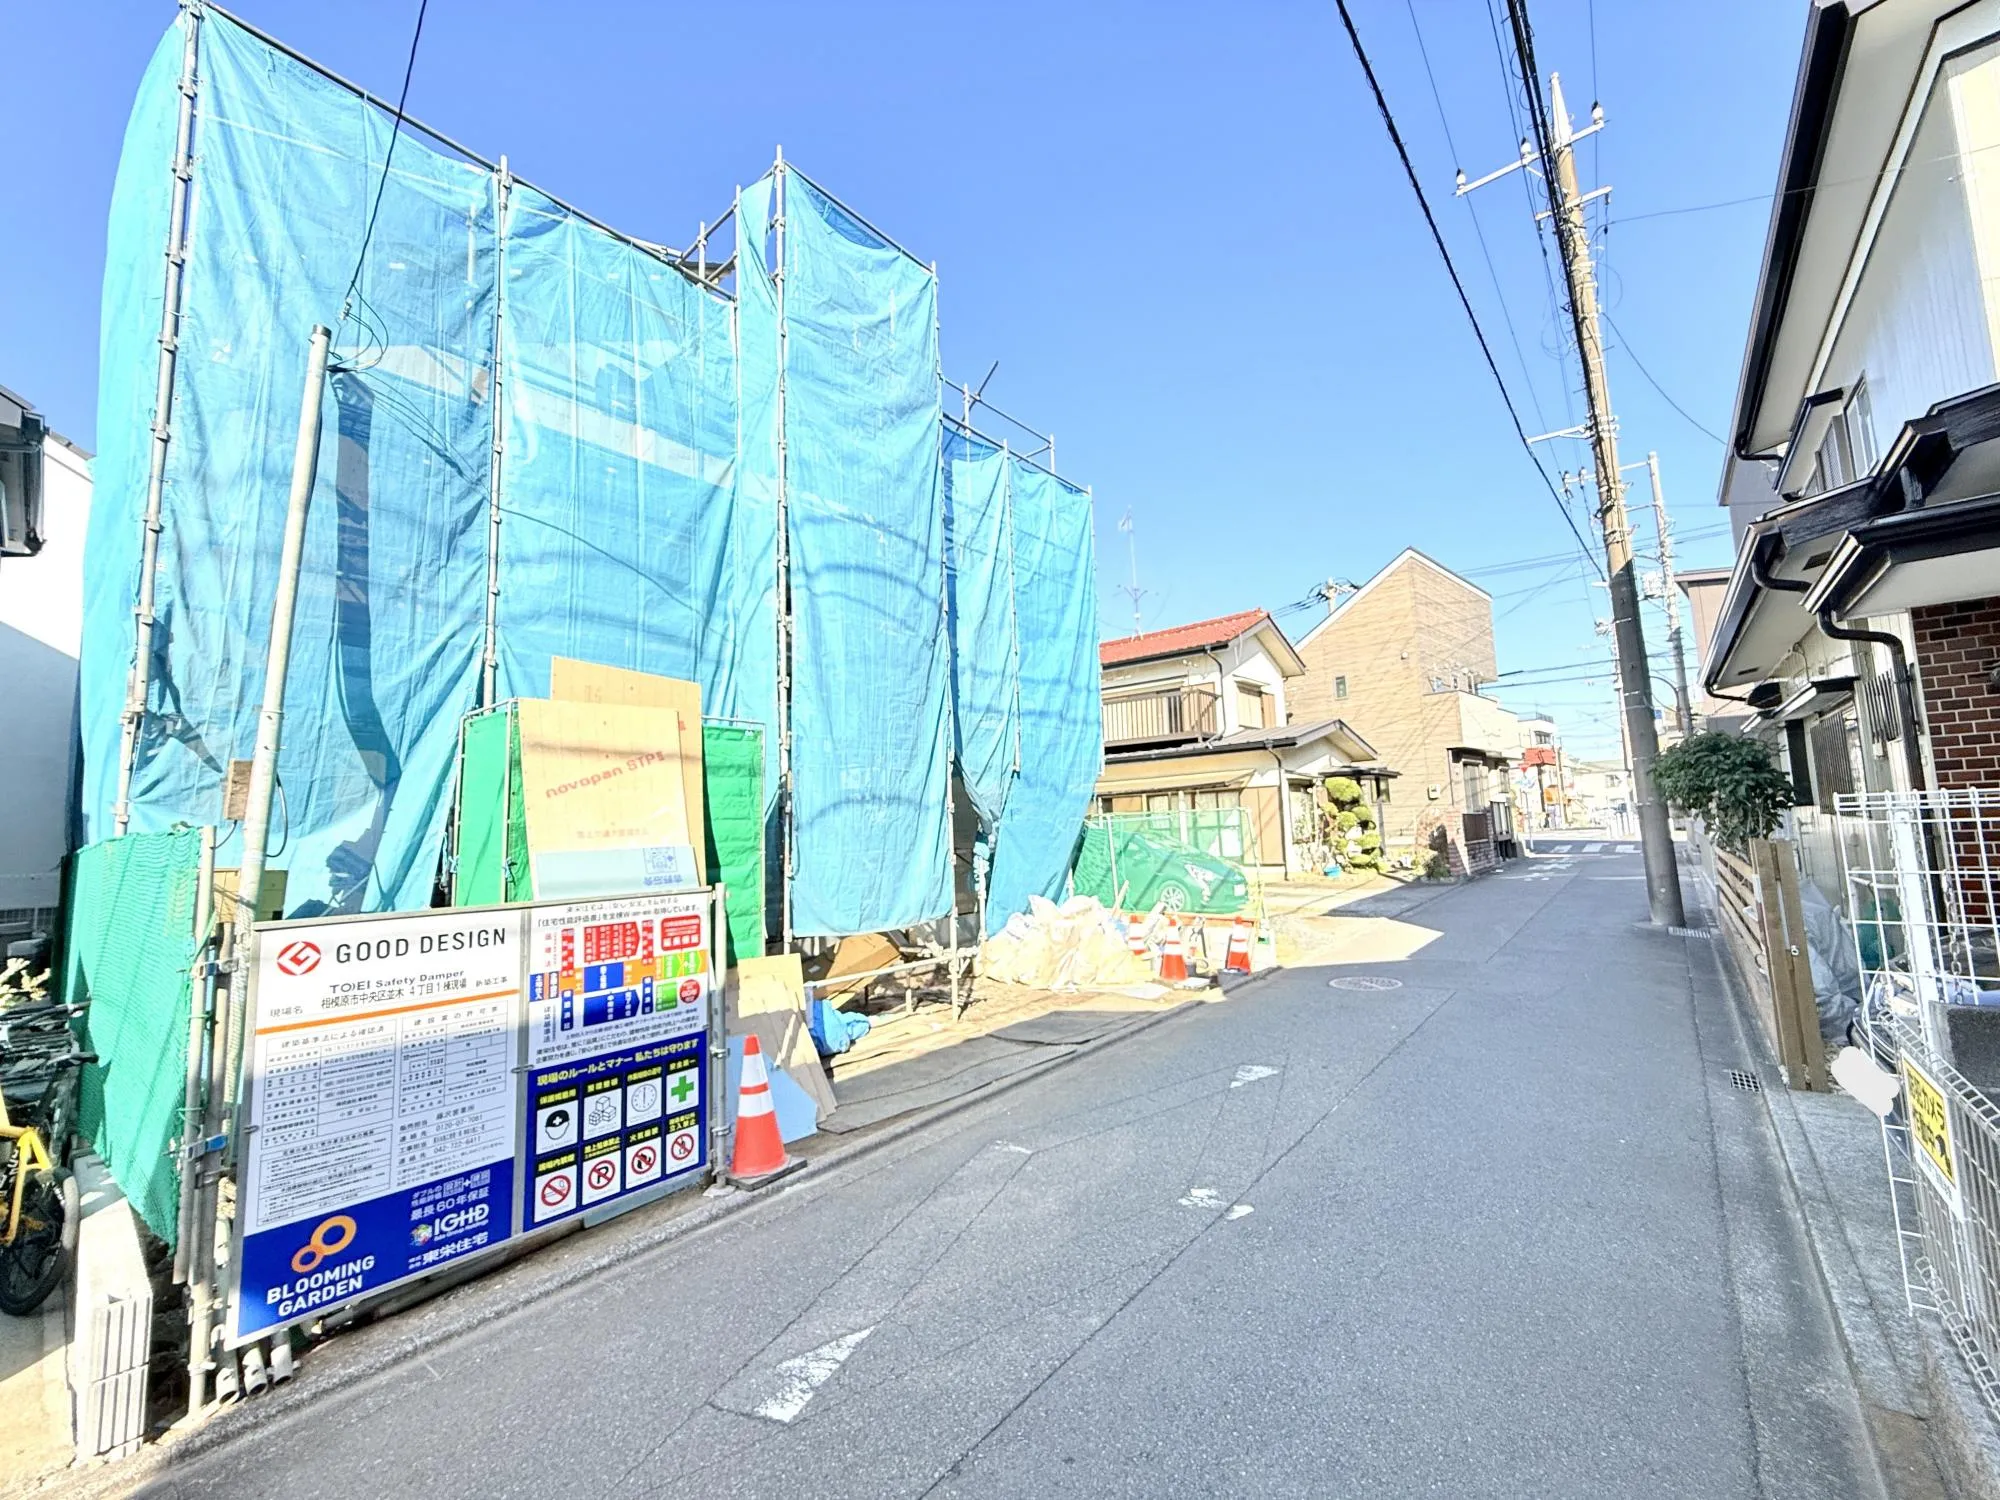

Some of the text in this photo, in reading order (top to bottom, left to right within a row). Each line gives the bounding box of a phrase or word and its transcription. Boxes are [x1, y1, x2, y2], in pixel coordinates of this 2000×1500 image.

[545, 767, 623, 798] novopan
[336, 927, 506, 964] GOOD DESIGN
[376, 976, 416, 989] Safety
[420, 970, 465, 983] Damper
[537, 1038, 699, 1086] 現場のルールとマナー 私たちは守ります
[422, 1231, 489, 1265] 東栄住宅
[267, 1255, 375, 1304] BLOOMING
[278, 1274, 364, 1317] GARDEN
